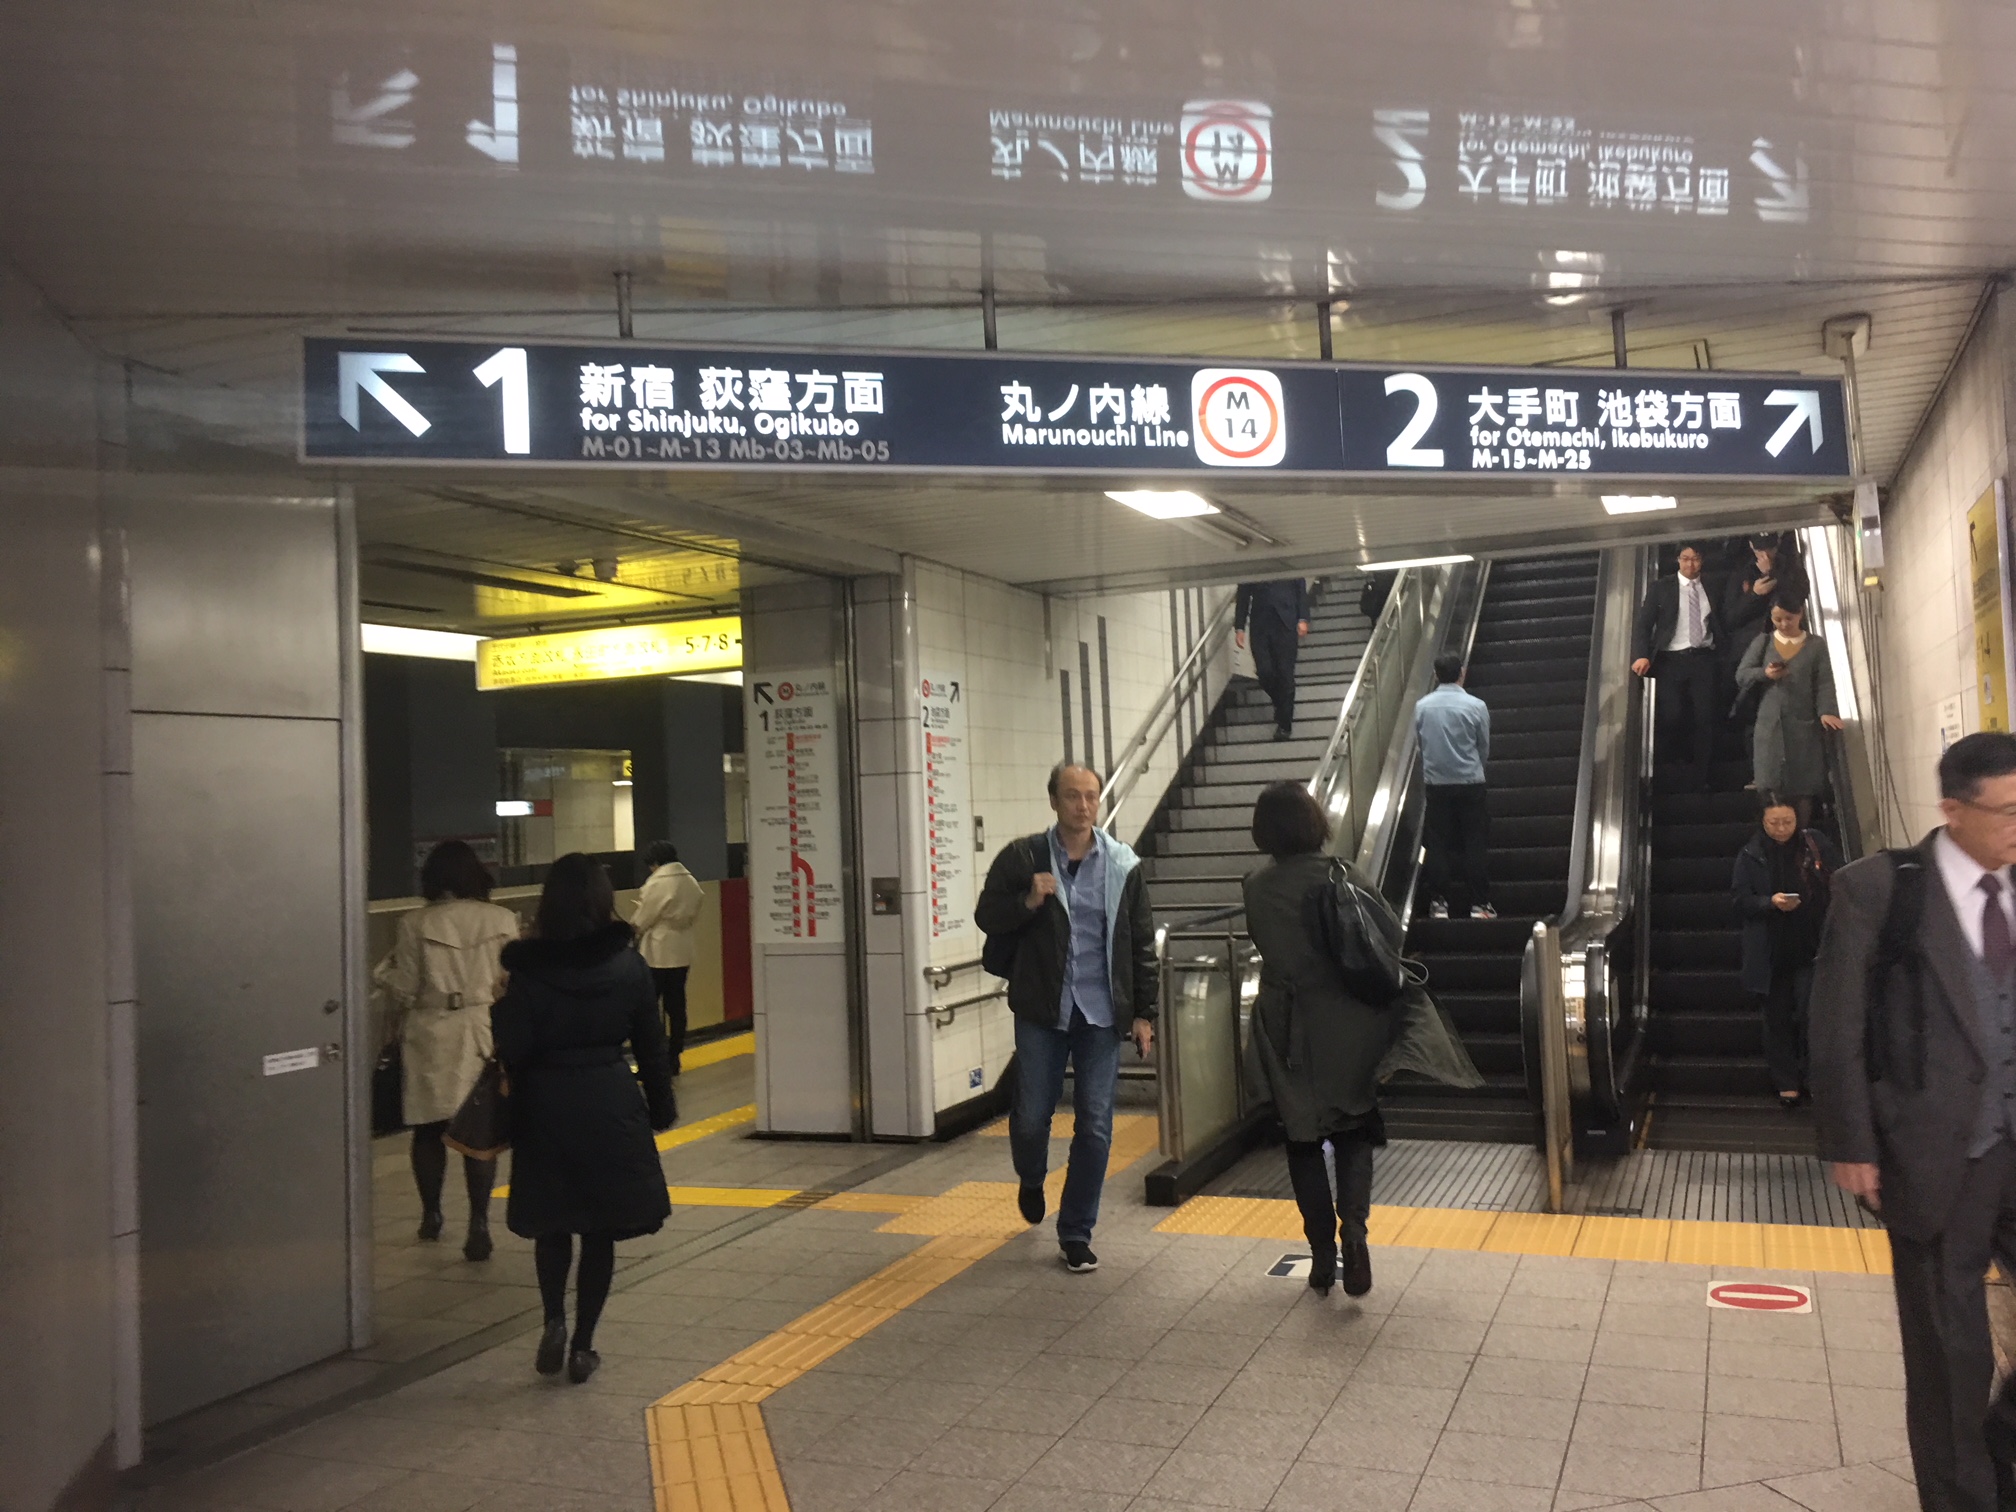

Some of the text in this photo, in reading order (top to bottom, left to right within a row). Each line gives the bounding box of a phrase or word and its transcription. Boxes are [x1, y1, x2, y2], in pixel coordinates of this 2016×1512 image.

[472, 347, 531, 455] 1
[579, 362, 885, 414] 新宿 荻窪方面
[1226, 391, 1251, 411] M
[1000, 380, 1171, 426] 丸ノ内線
[1468, 386, 1742, 430] 大手町 池袋方面
[580, 407, 860, 440] for Shinjuku, Ogikubo
[1224, 417, 1259, 440] 14
[1383, 372, 1445, 467] 2
[581, 435, 890, 462] M-01~M-13 Mb-03~Mb-05
[1002, 423, 1190, 448] Marunouchi Line
[1469, 425, 1709, 450] for Otemachi, Ikebukuro
[1471, 448, 1592, 470] M-15~M-25
[759, 710, 769, 732] 1
[922, 705, 930, 728] 2
